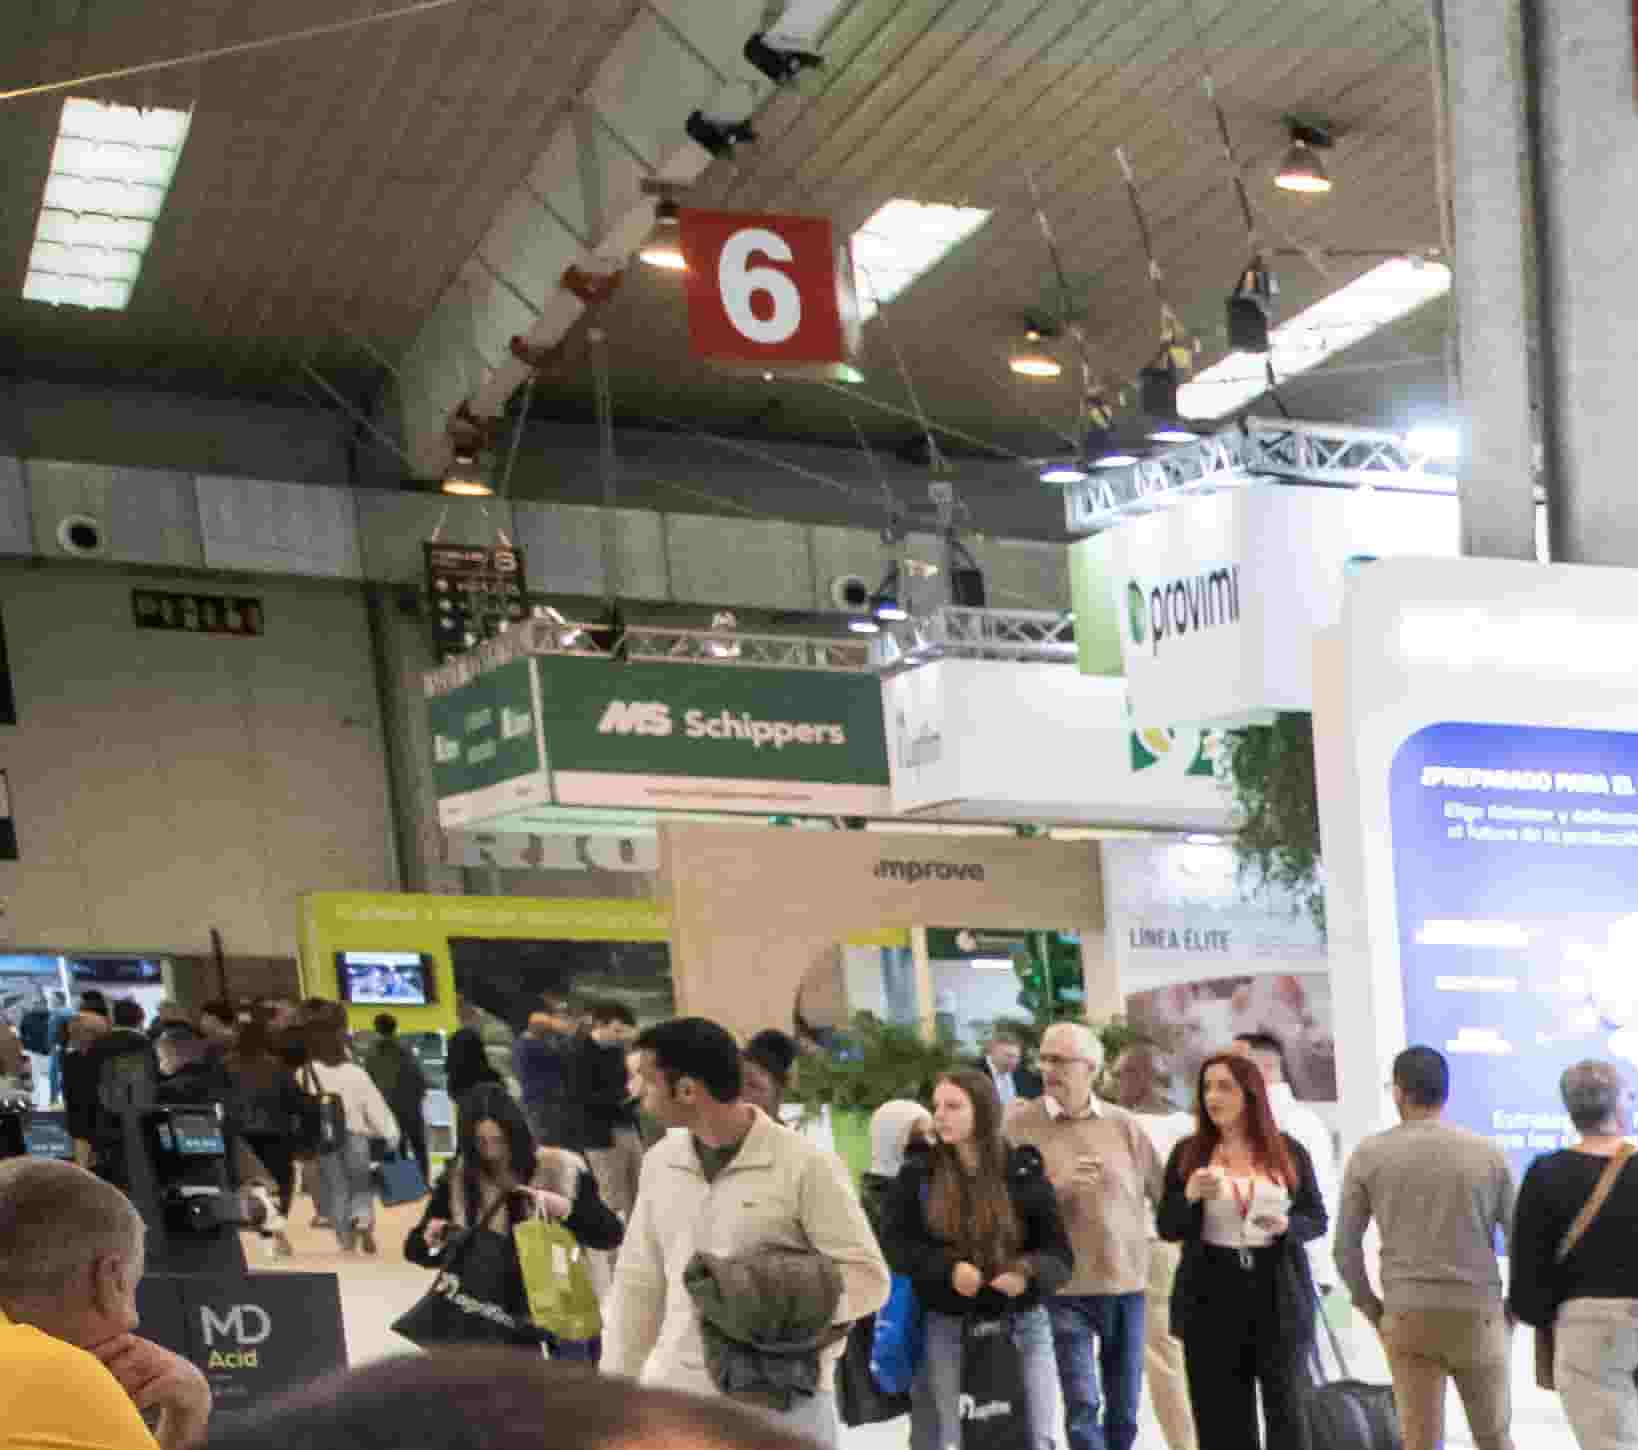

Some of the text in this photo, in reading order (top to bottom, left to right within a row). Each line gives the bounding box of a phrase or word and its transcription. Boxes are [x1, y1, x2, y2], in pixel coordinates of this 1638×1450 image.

[717, 228, 801, 345] 6
[1150, 564, 1241, 658] provimi
[598, 700, 847, 749] MS Schippers
[201, 1303, 273, 1346] MD
[208, 1349, 259, 1370] Acid
